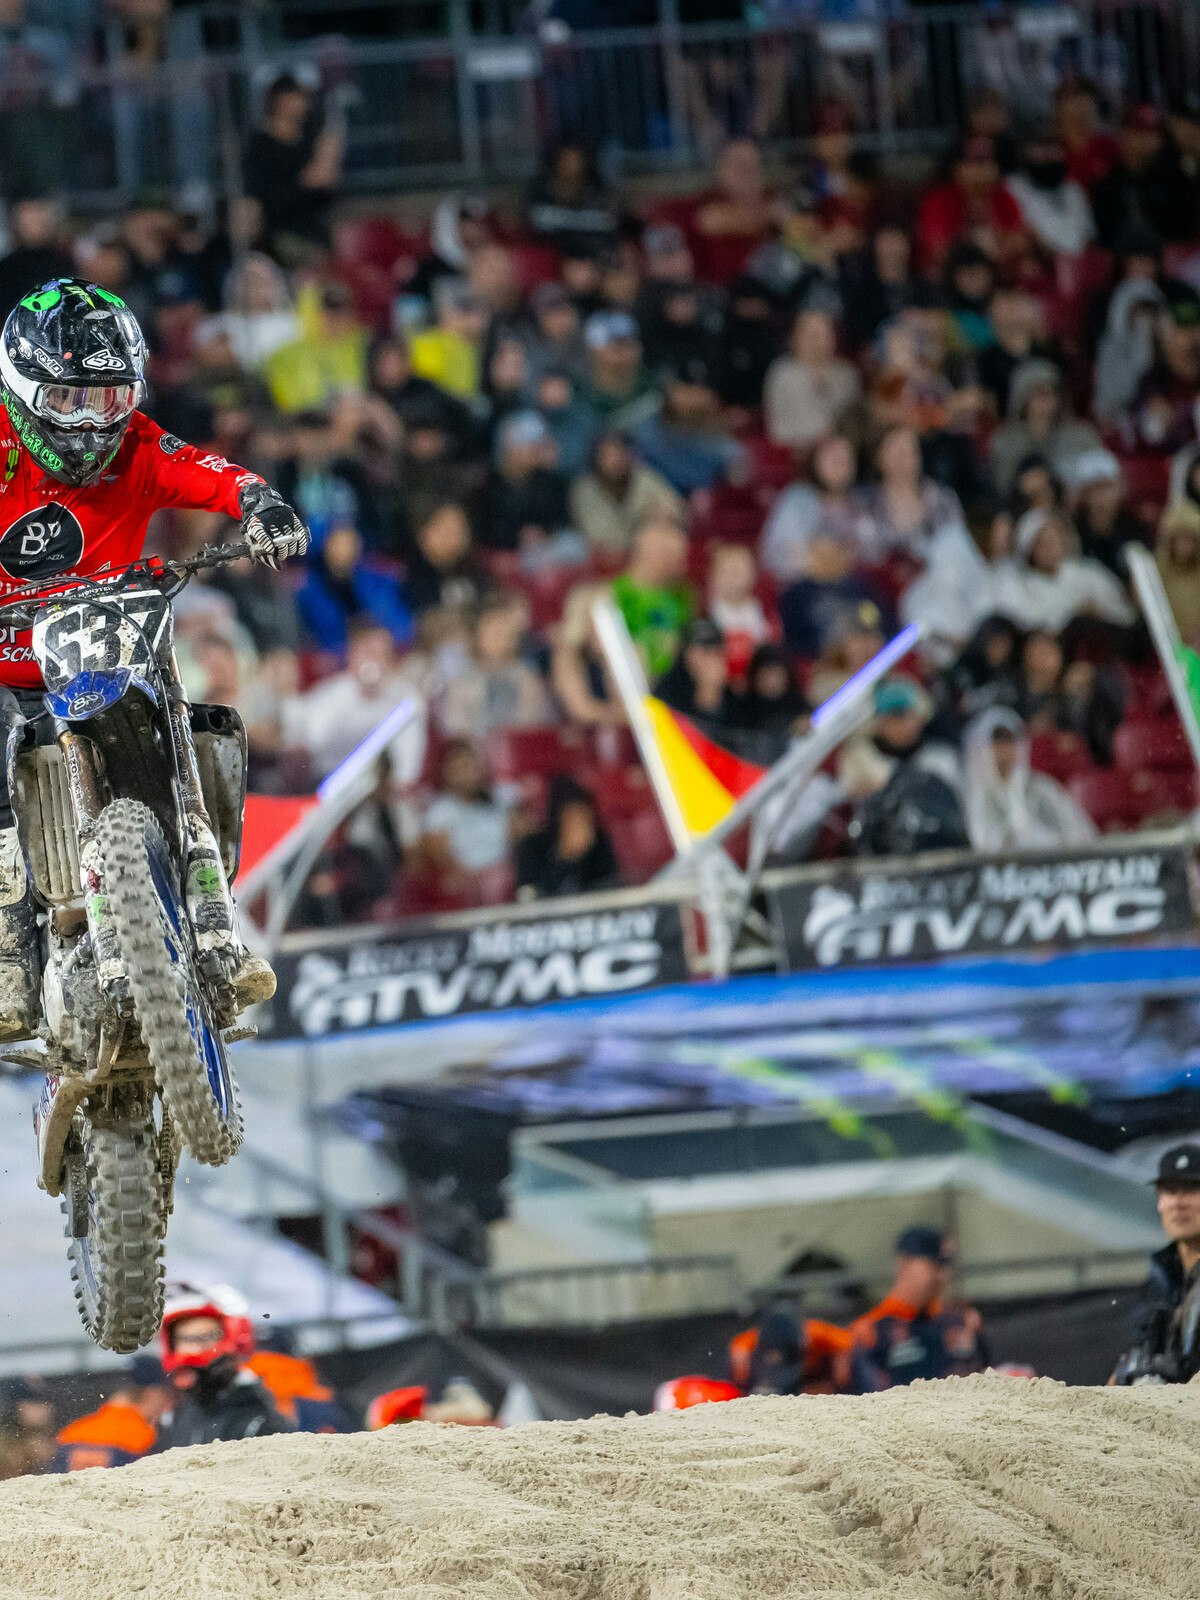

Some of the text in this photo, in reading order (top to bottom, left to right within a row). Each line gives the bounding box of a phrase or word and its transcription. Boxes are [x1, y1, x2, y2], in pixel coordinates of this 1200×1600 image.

[21, 422, 43, 455] LAB
[41, 447, 64, 472] CBD
[978, 853, 1165, 900] MOUNTAIN
[467, 905, 658, 965] MOUNTAIN
